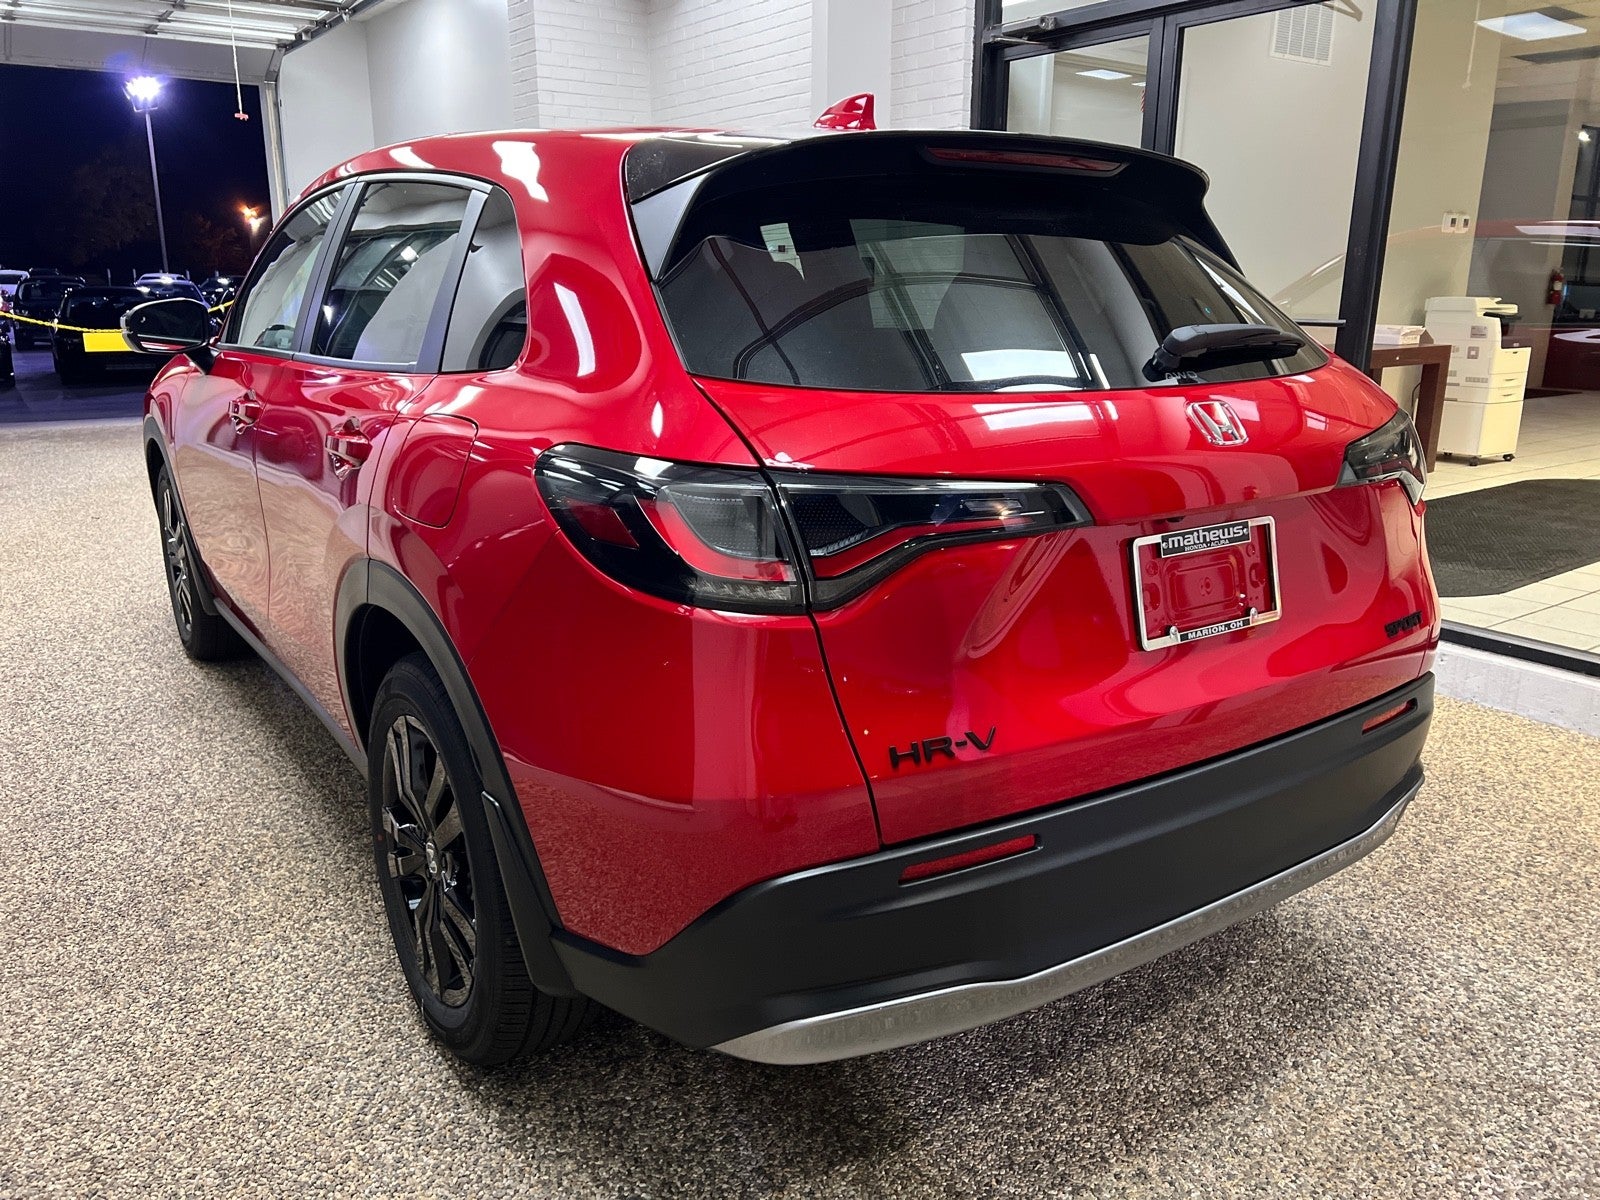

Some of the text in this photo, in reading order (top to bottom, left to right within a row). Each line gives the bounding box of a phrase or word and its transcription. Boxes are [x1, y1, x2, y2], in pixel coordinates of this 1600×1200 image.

[1168, 525, 1243, 548] mathews
[1184, 538, 1230, 552] HONDA ACURA
[1230, 620, 1244, 631] OH
[888, 725, 996, 769] HR-V
